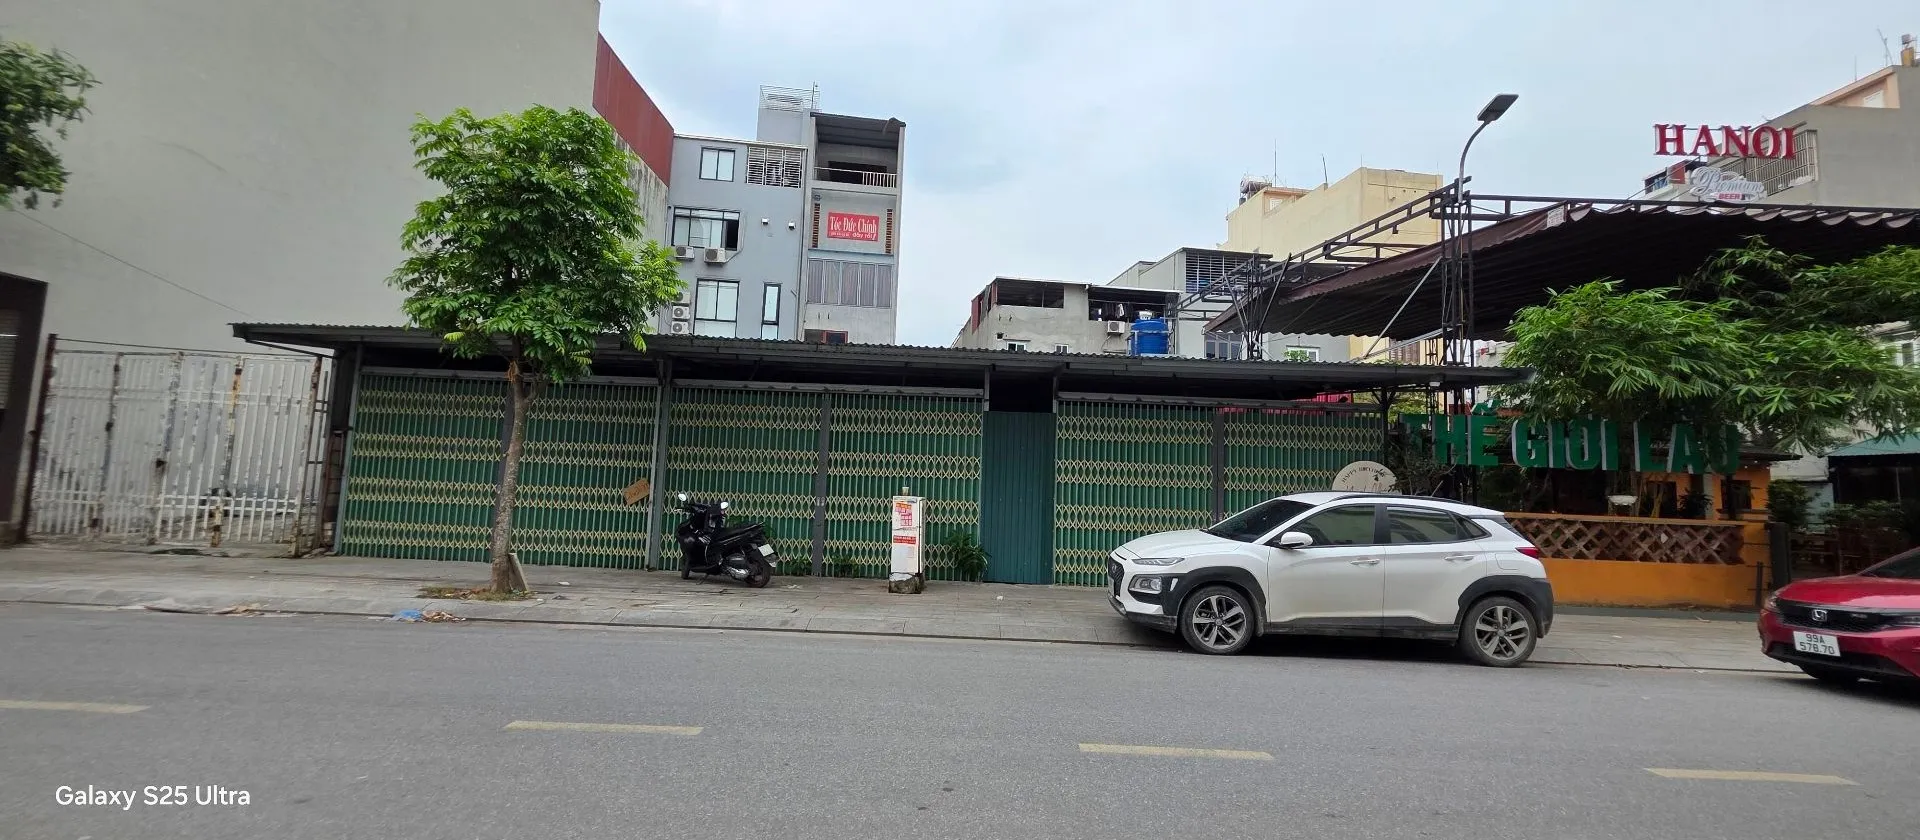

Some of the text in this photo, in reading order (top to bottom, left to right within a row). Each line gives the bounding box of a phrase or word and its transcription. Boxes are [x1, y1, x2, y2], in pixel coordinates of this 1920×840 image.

[1653, 124, 1797, 160] HANOI
[1690, 166, 1765, 197] Premium
[830, 216, 877, 233] Tóc Đức Chính
[1806, 634, 1825, 644] 99A
[1800, 642, 1835, 654] 578.70
